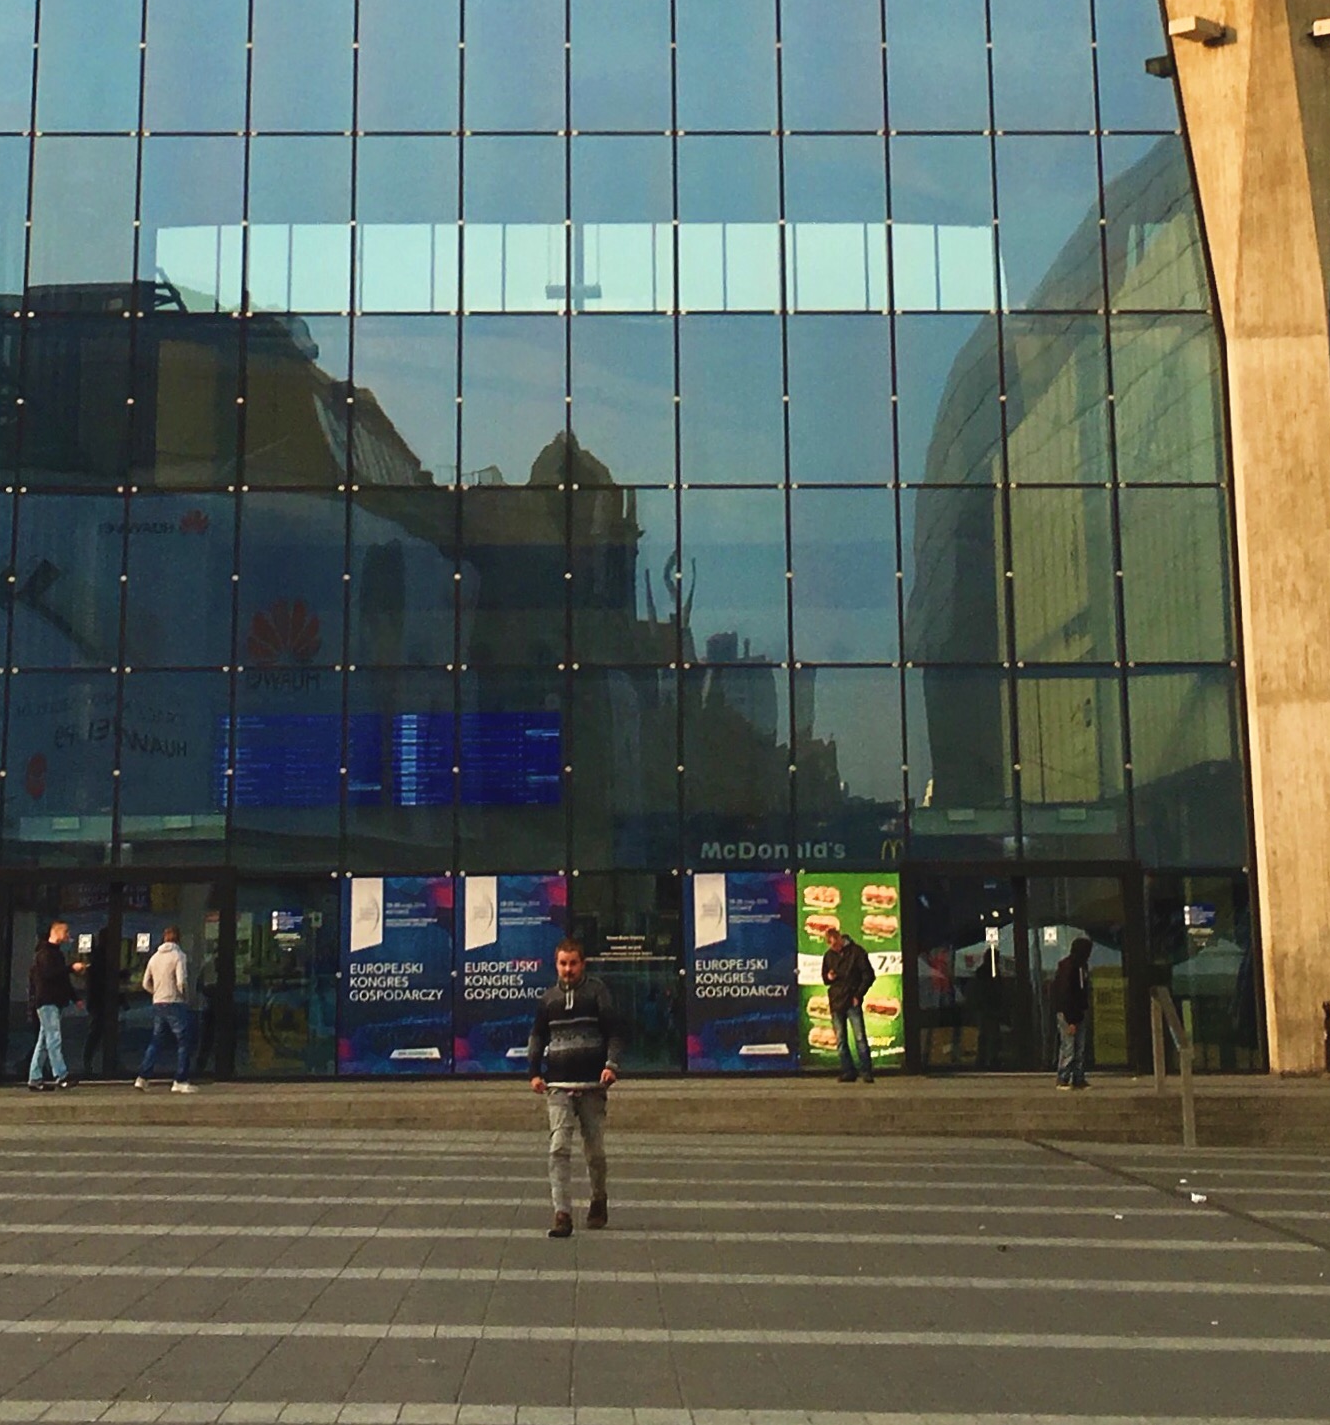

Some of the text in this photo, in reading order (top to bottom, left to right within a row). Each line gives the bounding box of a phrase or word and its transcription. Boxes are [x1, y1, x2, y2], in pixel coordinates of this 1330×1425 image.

[349, 962, 423, 975] EUROPEJSKI
[464, 961, 538, 973] EUROPEJSKI
[695, 959, 768, 971] EUROPEJSKI
[349, 976, 409, 988] KONGRES
[464, 974, 524, 986] KONGRES
[695, 972, 754, 984] KONGRES
[349, 989, 444, 1002] GOSPODARCZY
[464, 987, 546, 1000] GOSPODARC
[695, 985, 789, 998] GOSPODARCZY
